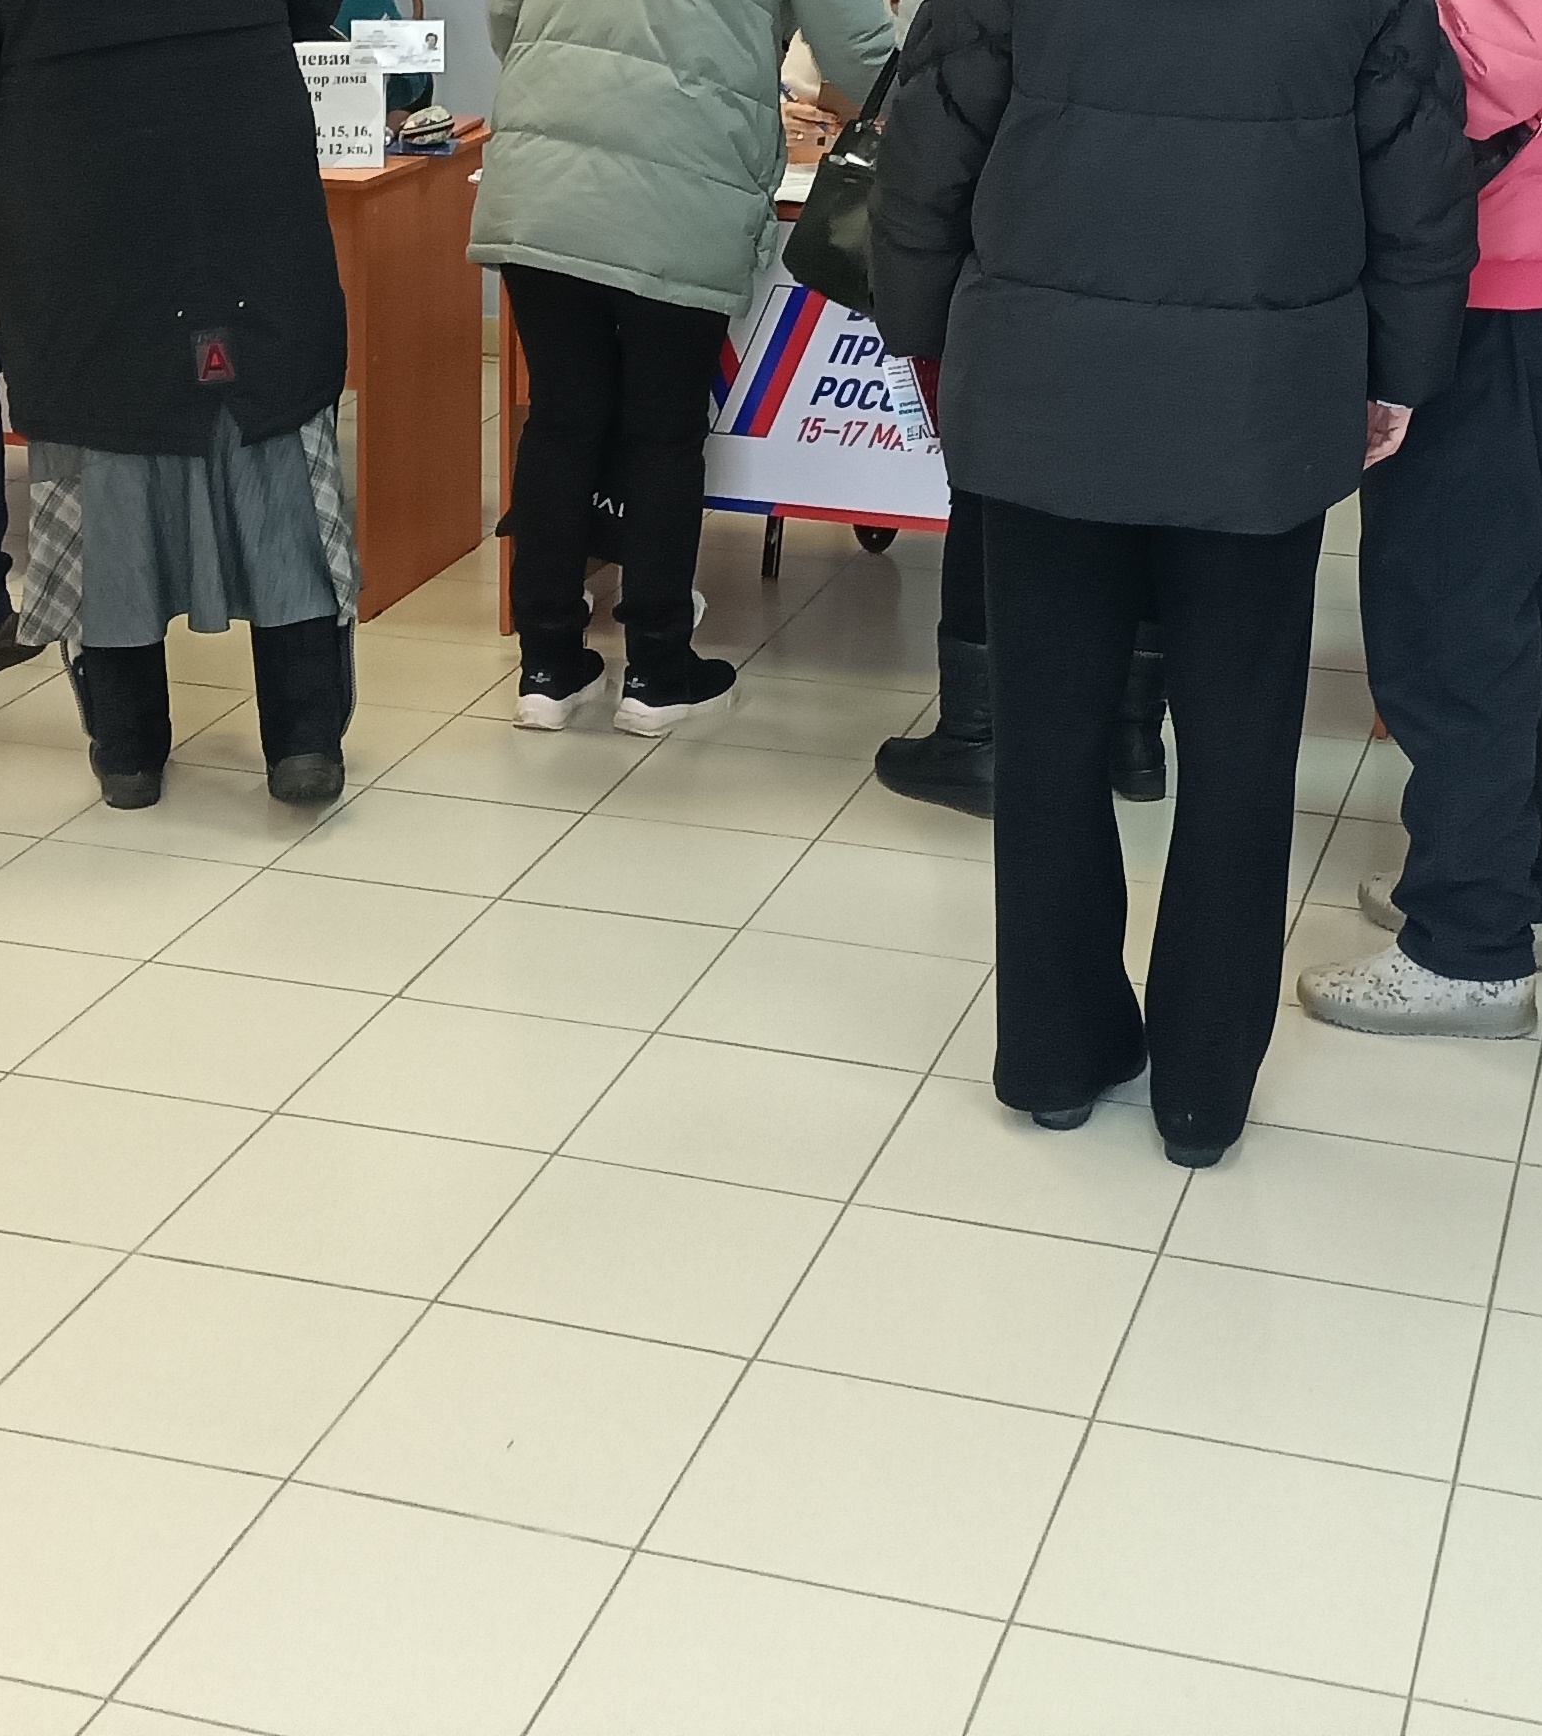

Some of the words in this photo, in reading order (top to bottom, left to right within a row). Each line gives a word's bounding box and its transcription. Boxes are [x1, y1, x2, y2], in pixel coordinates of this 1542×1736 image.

[304, 75, 329, 87] тор
[332, 72, 367, 84] дома
[331, 125, 349, 138] 15,
[329, 143, 342, 155] 12
